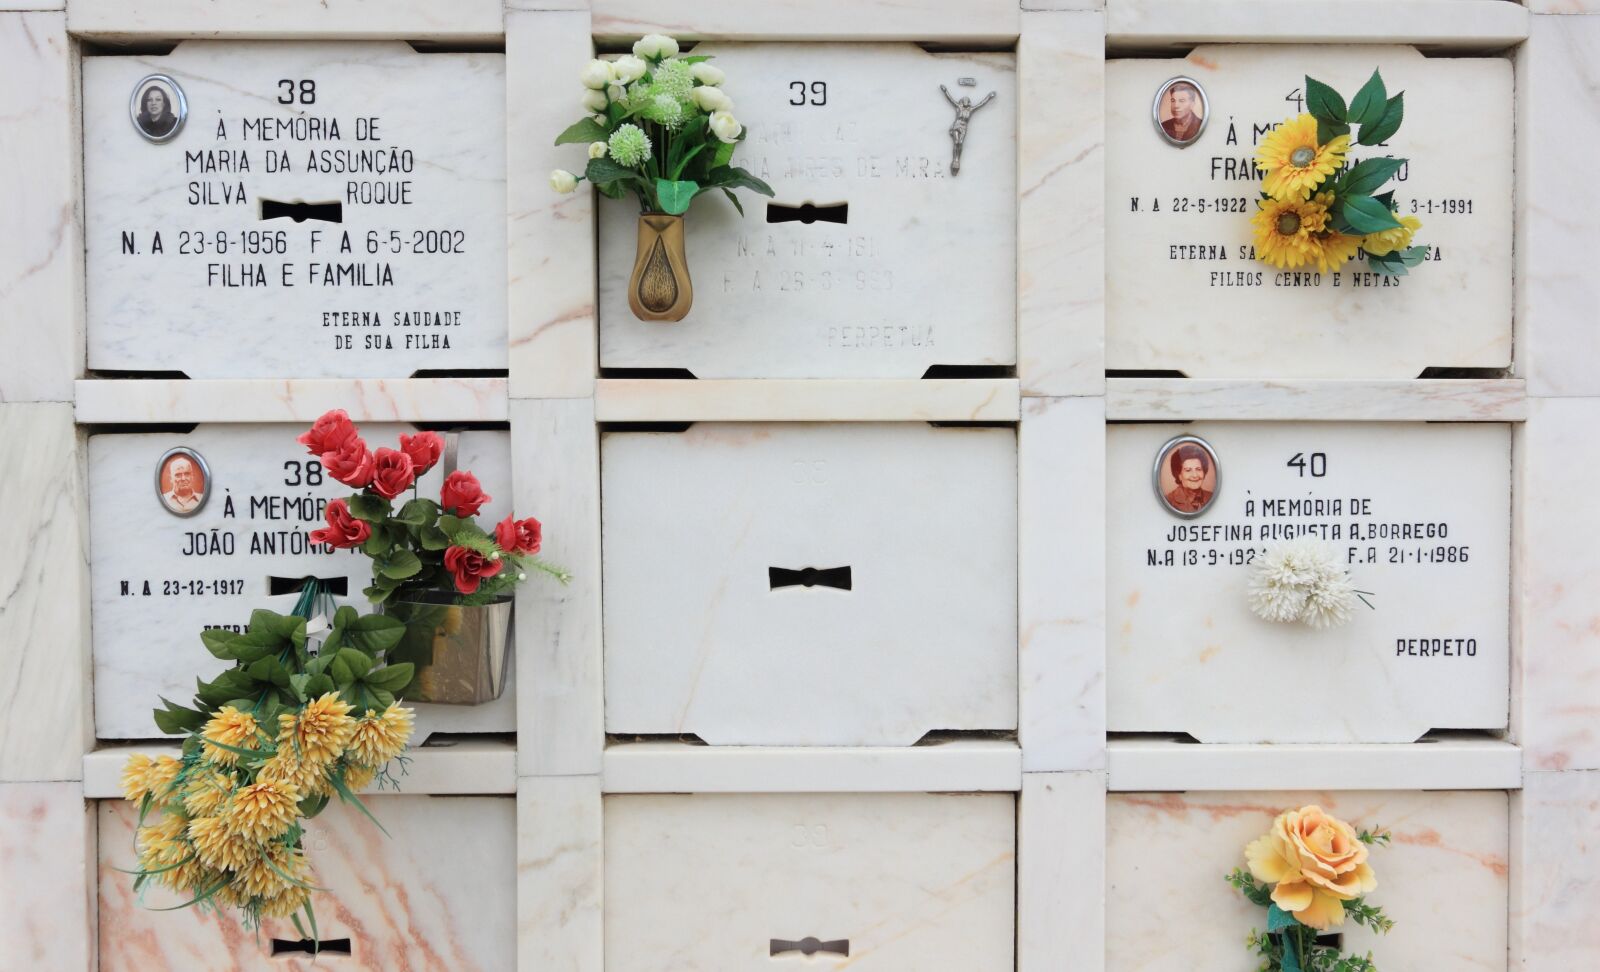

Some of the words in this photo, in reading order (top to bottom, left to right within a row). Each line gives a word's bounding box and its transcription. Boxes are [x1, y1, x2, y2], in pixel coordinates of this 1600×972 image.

[278, 79, 316, 104] 38
[789, 81, 827, 107] 39
[1285, 88, 1304, 112] 4
[216, 109, 227, 141] À
[243, 111, 341, 141] MEMÓRIA
[356, 117, 381, 141] DE
[185, 150, 250, 173] MARIA
[266, 150, 291, 173] DA
[307, 146, 414, 176] ASSUNÇÃO
[188, 181, 247, 205] SILVA
[347, 181, 413, 205] ROQUE
[1152, 197, 1160, 212] A
[1172, 197, 1247, 213] 22-5-1922
[1411, 199, 1473, 214] 3-1-1991
[122, 230, 140, 254] N.
[152, 230, 163, 254] A
[179, 230, 287, 254] 23-8-1956
[340, 230, 352, 253] A
[366, 230, 465, 253] 6-5-2002
[1169, 245, 1227, 260] ETERNA
[208, 263, 267, 287] FILHA
[282, 263, 294, 287] E
[309, 263, 394, 287] FAMILIA
[1210, 271, 1262, 287] FILHOS
[1333, 272, 1341, 287] E
[1353, 272, 1400, 287] NETAS
[322, 312, 381, 326] ETERNA
[394, 311, 461, 326] SAUDADE
[335, 335, 353, 349] DE
[365, 335, 392, 349] SUA
[405, 334, 451, 349] FILHA
[284, 460, 323, 487] 38
[1286, 452, 1327, 478] 40
[224, 488, 235, 519] À
[250, 492, 334, 521] MEMÓR
[1262, 491, 1343, 517] MEMÓRIA
[1350, 498, 1372, 516] DE
[183, 528, 235, 556] JOÃO
[1167, 525, 1252, 542] JOSEFINA
[142, 580, 151, 596] A
[163, 579, 244, 596] 23-12-1917
[1396, 638, 1478, 657] PERPETO
